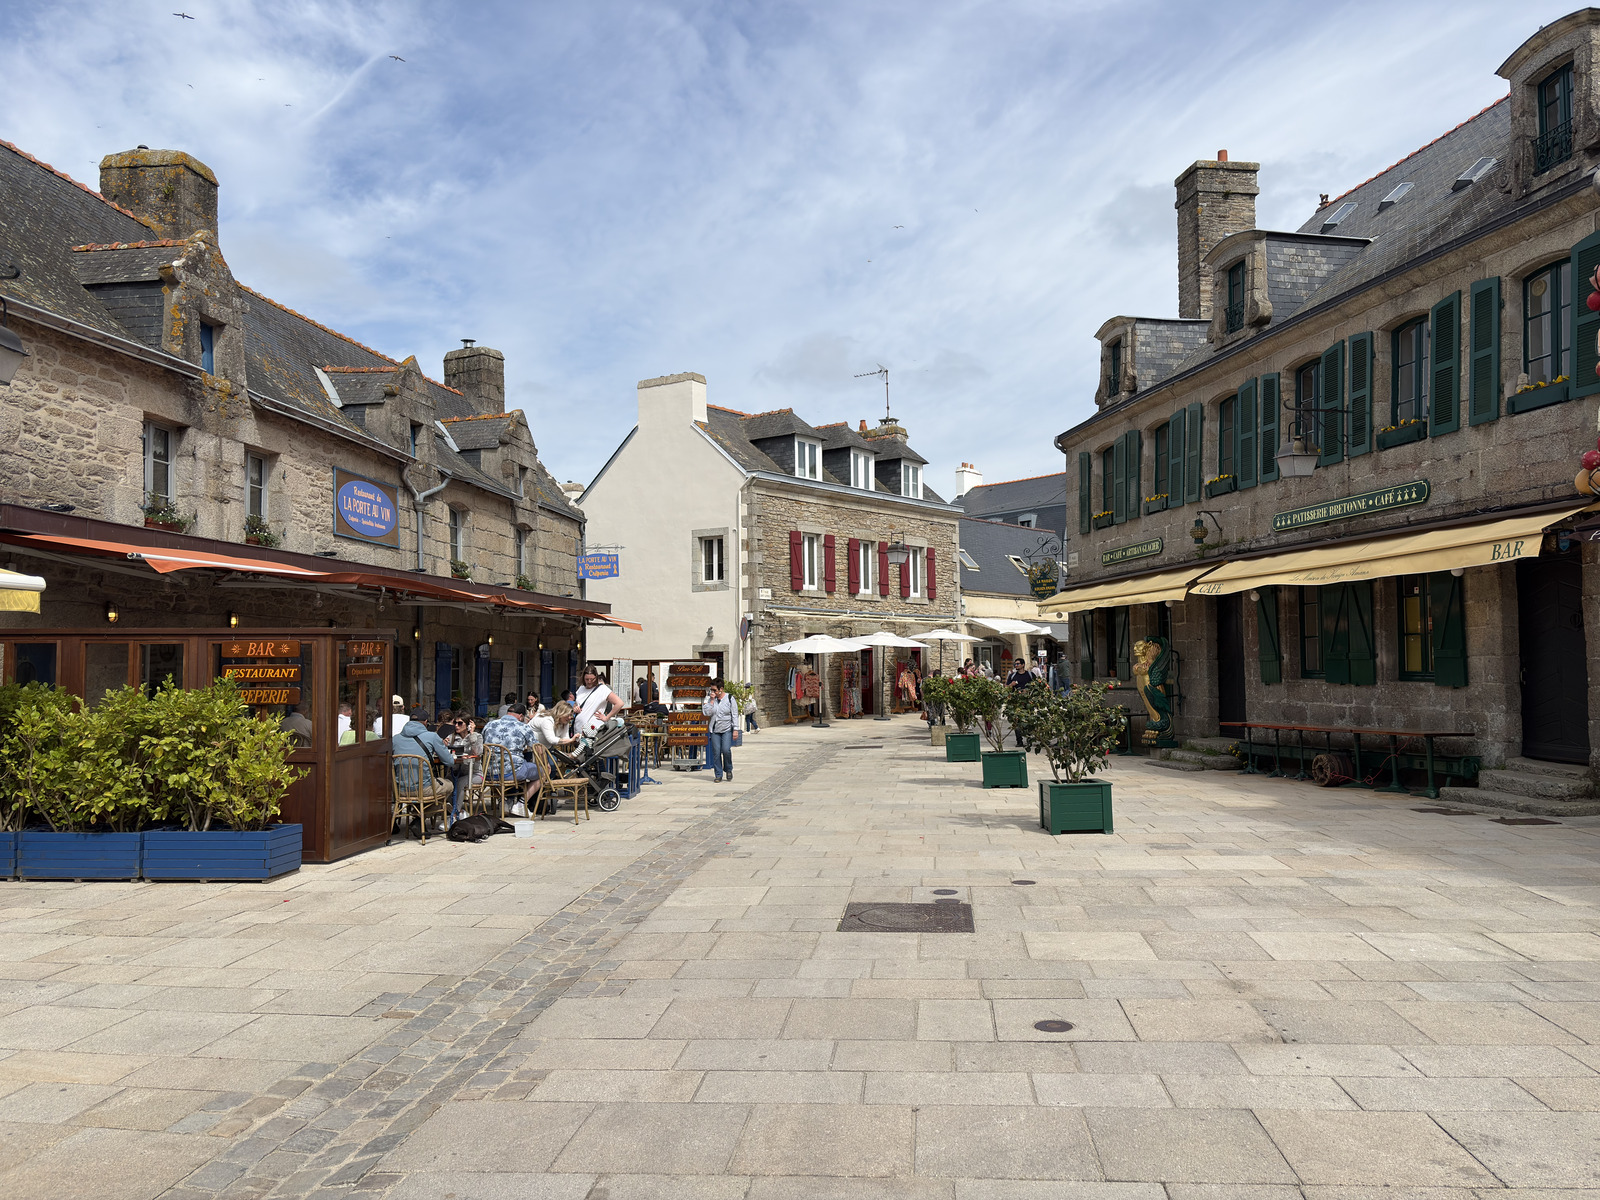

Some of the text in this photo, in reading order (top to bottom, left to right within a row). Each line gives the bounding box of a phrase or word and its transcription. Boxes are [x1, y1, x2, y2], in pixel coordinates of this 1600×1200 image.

[354, 486, 382, 503] Restaurant de
[343, 496, 391, 522] LA PORTE AU VIN
[1293, 489, 1395, 524] PATISSERIE BRETONNE CAFÉ
[1490, 540, 1525, 561] BAR
[246, 642, 275, 657] BAR
[360, 642, 375, 656] BAR
[224, 668, 298, 678] RESTAURANT
[235, 689, 290, 704] REPERIE
[676, 712, 702, 721] OUVERT
